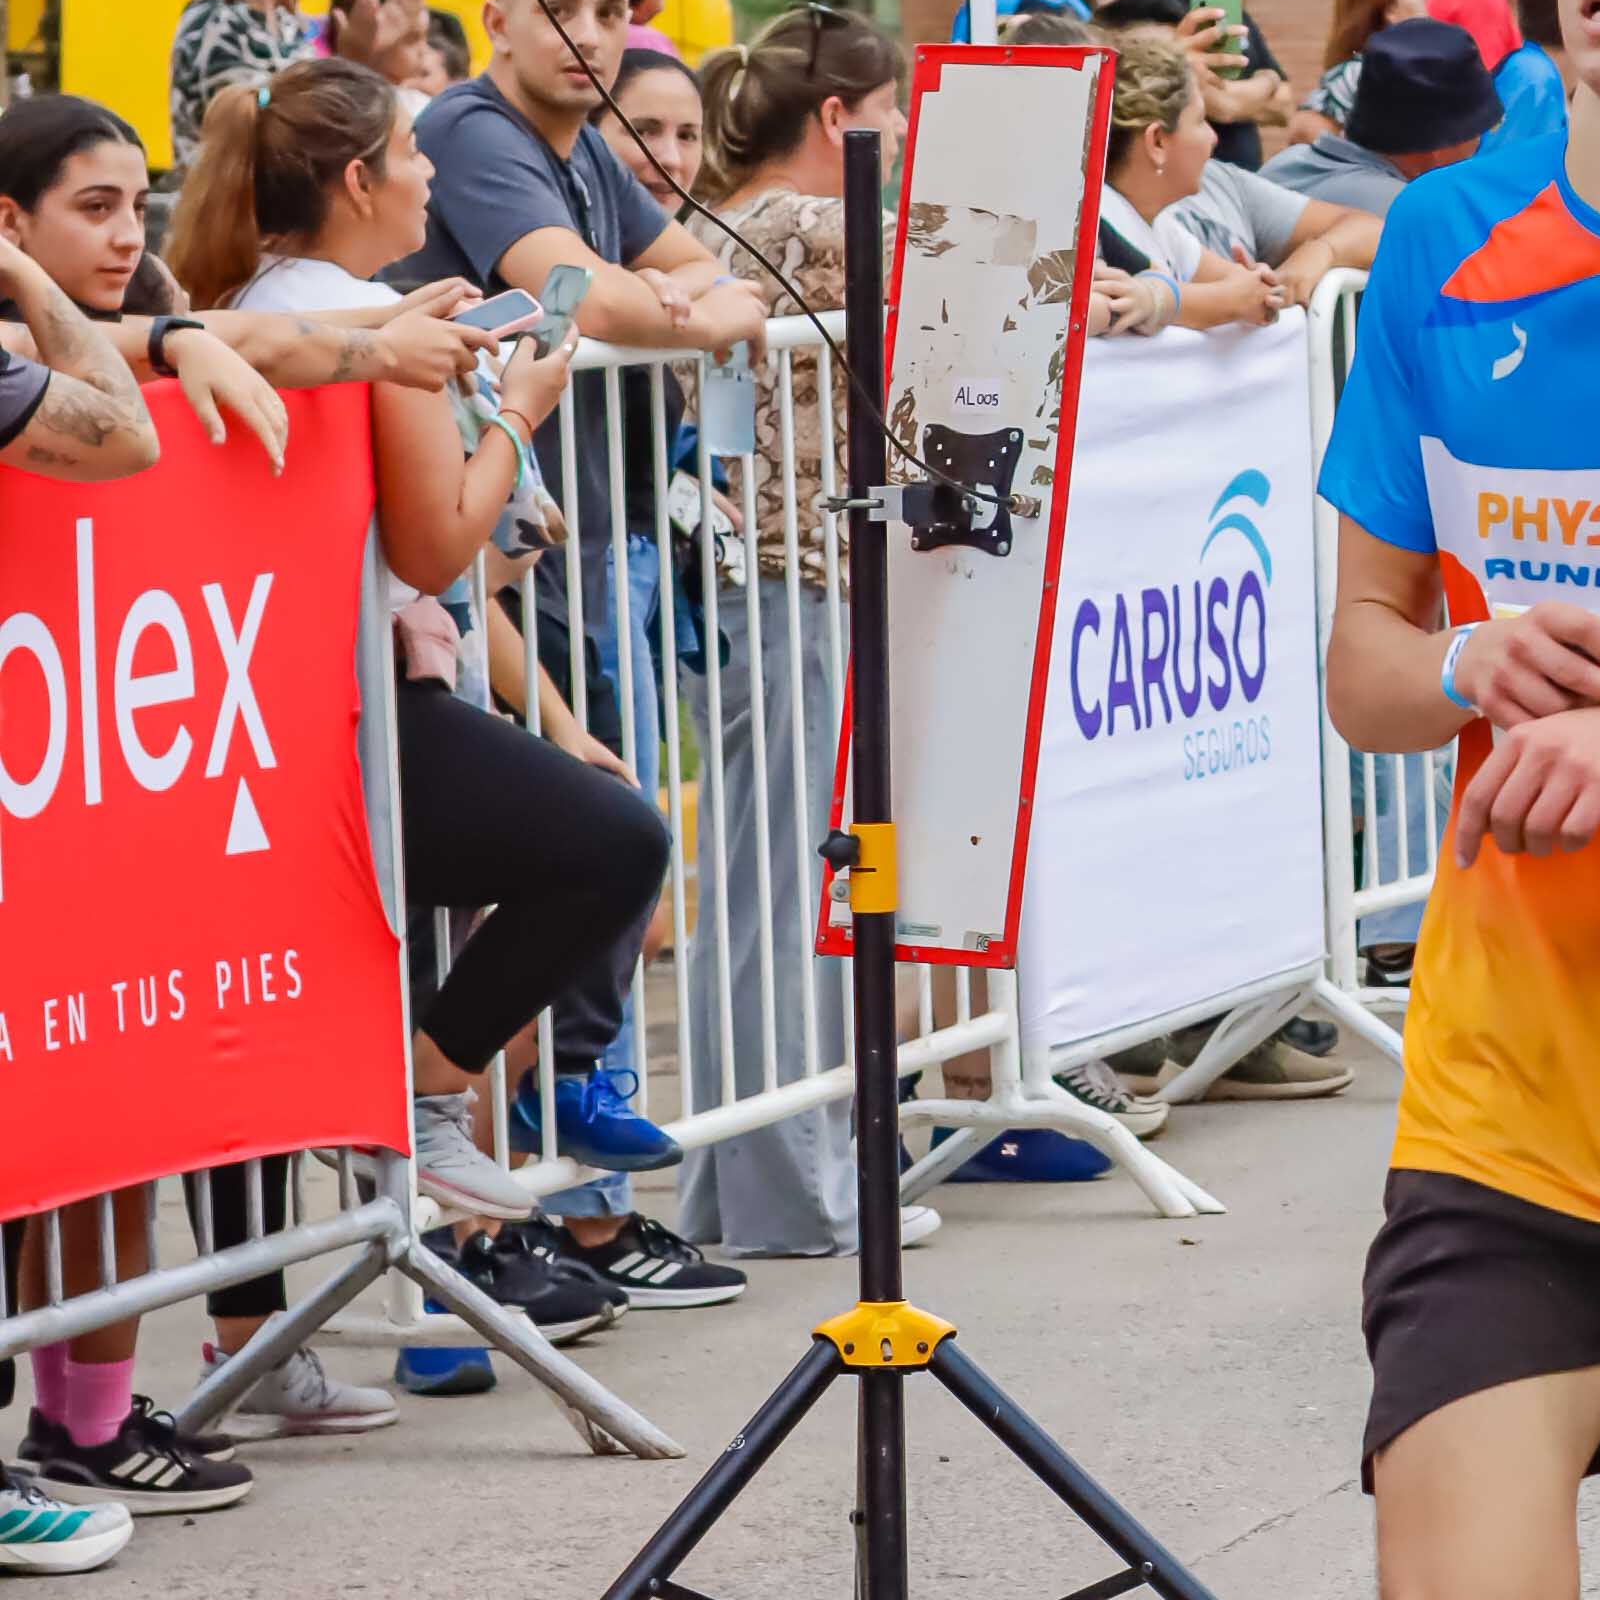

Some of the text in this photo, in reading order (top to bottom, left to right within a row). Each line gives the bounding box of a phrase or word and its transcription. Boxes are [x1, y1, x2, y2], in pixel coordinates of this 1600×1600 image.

[1070, 570, 1267, 741] CARUSO
[1183, 714, 1272, 781] SEGUROS
[44, 998, 87, 1051] EN
[112, 969, 186, 1032] TUS
[215, 949, 302, 1009] PIES
